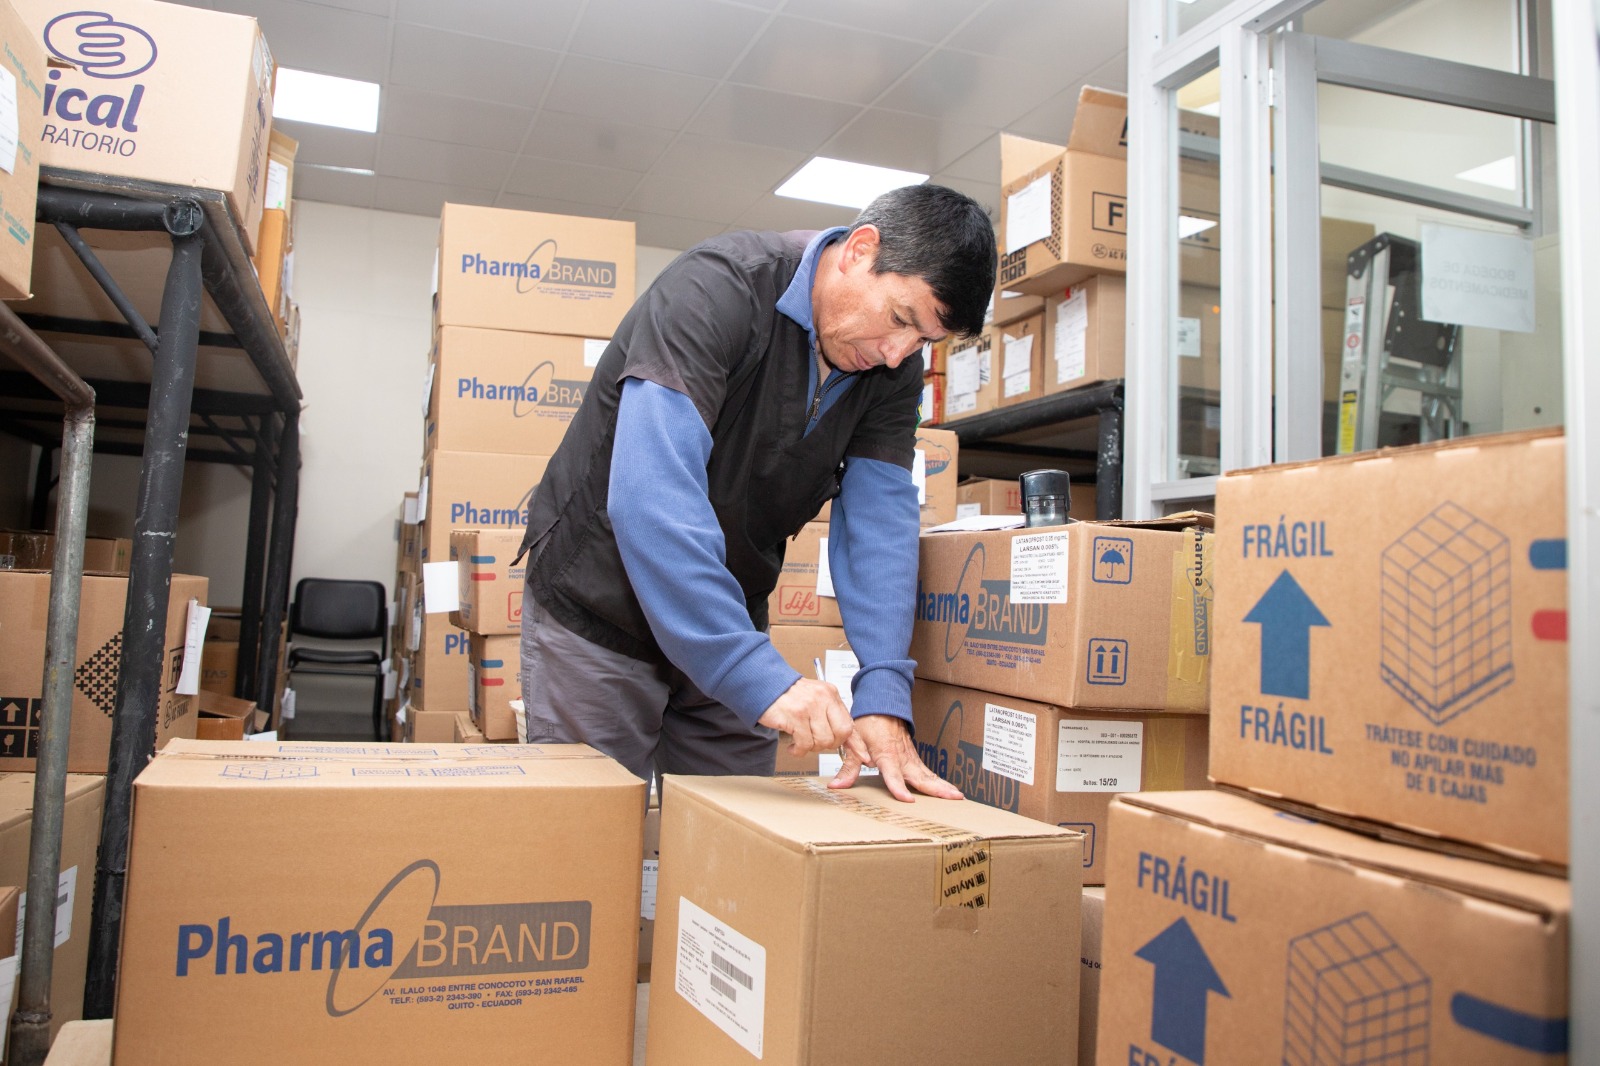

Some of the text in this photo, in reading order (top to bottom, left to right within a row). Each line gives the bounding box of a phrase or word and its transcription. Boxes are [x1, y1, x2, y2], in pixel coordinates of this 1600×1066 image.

[461, 253, 613, 285] Pharma BRAND
[458, 377, 538, 402] Pharma
[451, 501, 529, 526] Pharma
[1243, 514, 1334, 559] FRÁGIL
[974, 587, 1043, 635] BRAND
[1195, 596, 1206, 653] BRAND
[1240, 702, 1334, 756] FRÁGIL
[1366, 721, 1537, 767] TRÁTESE CON CUIDADO
[953, 745, 1015, 810] BRAND
[1099, 778, 1117, 786] 15/20
[1391, 749, 1504, 785] NO APILAR MÁS
[1406, 772, 1422, 791] DE
[1441, 778, 1487, 804] CAJAS
[945, 855, 976, 875] Mylan
[944, 877, 975, 898] Mylan
[1138, 851, 1238, 923] FRÁGIL
[176, 916, 581, 977] Pharma BRAND
[383, 976, 584, 996] AV. ILALO 1048 ENTRE CONOCOTO Y SAN RAFAEL
[416, 995, 444, 1004] (593-2)
[495, 990, 513, 998] FAX:
[515, 988, 542, 998] (593-2)
[448, 1001, 475, 1010] QUITO
[482, 999, 523, 1008] ECUADOR
